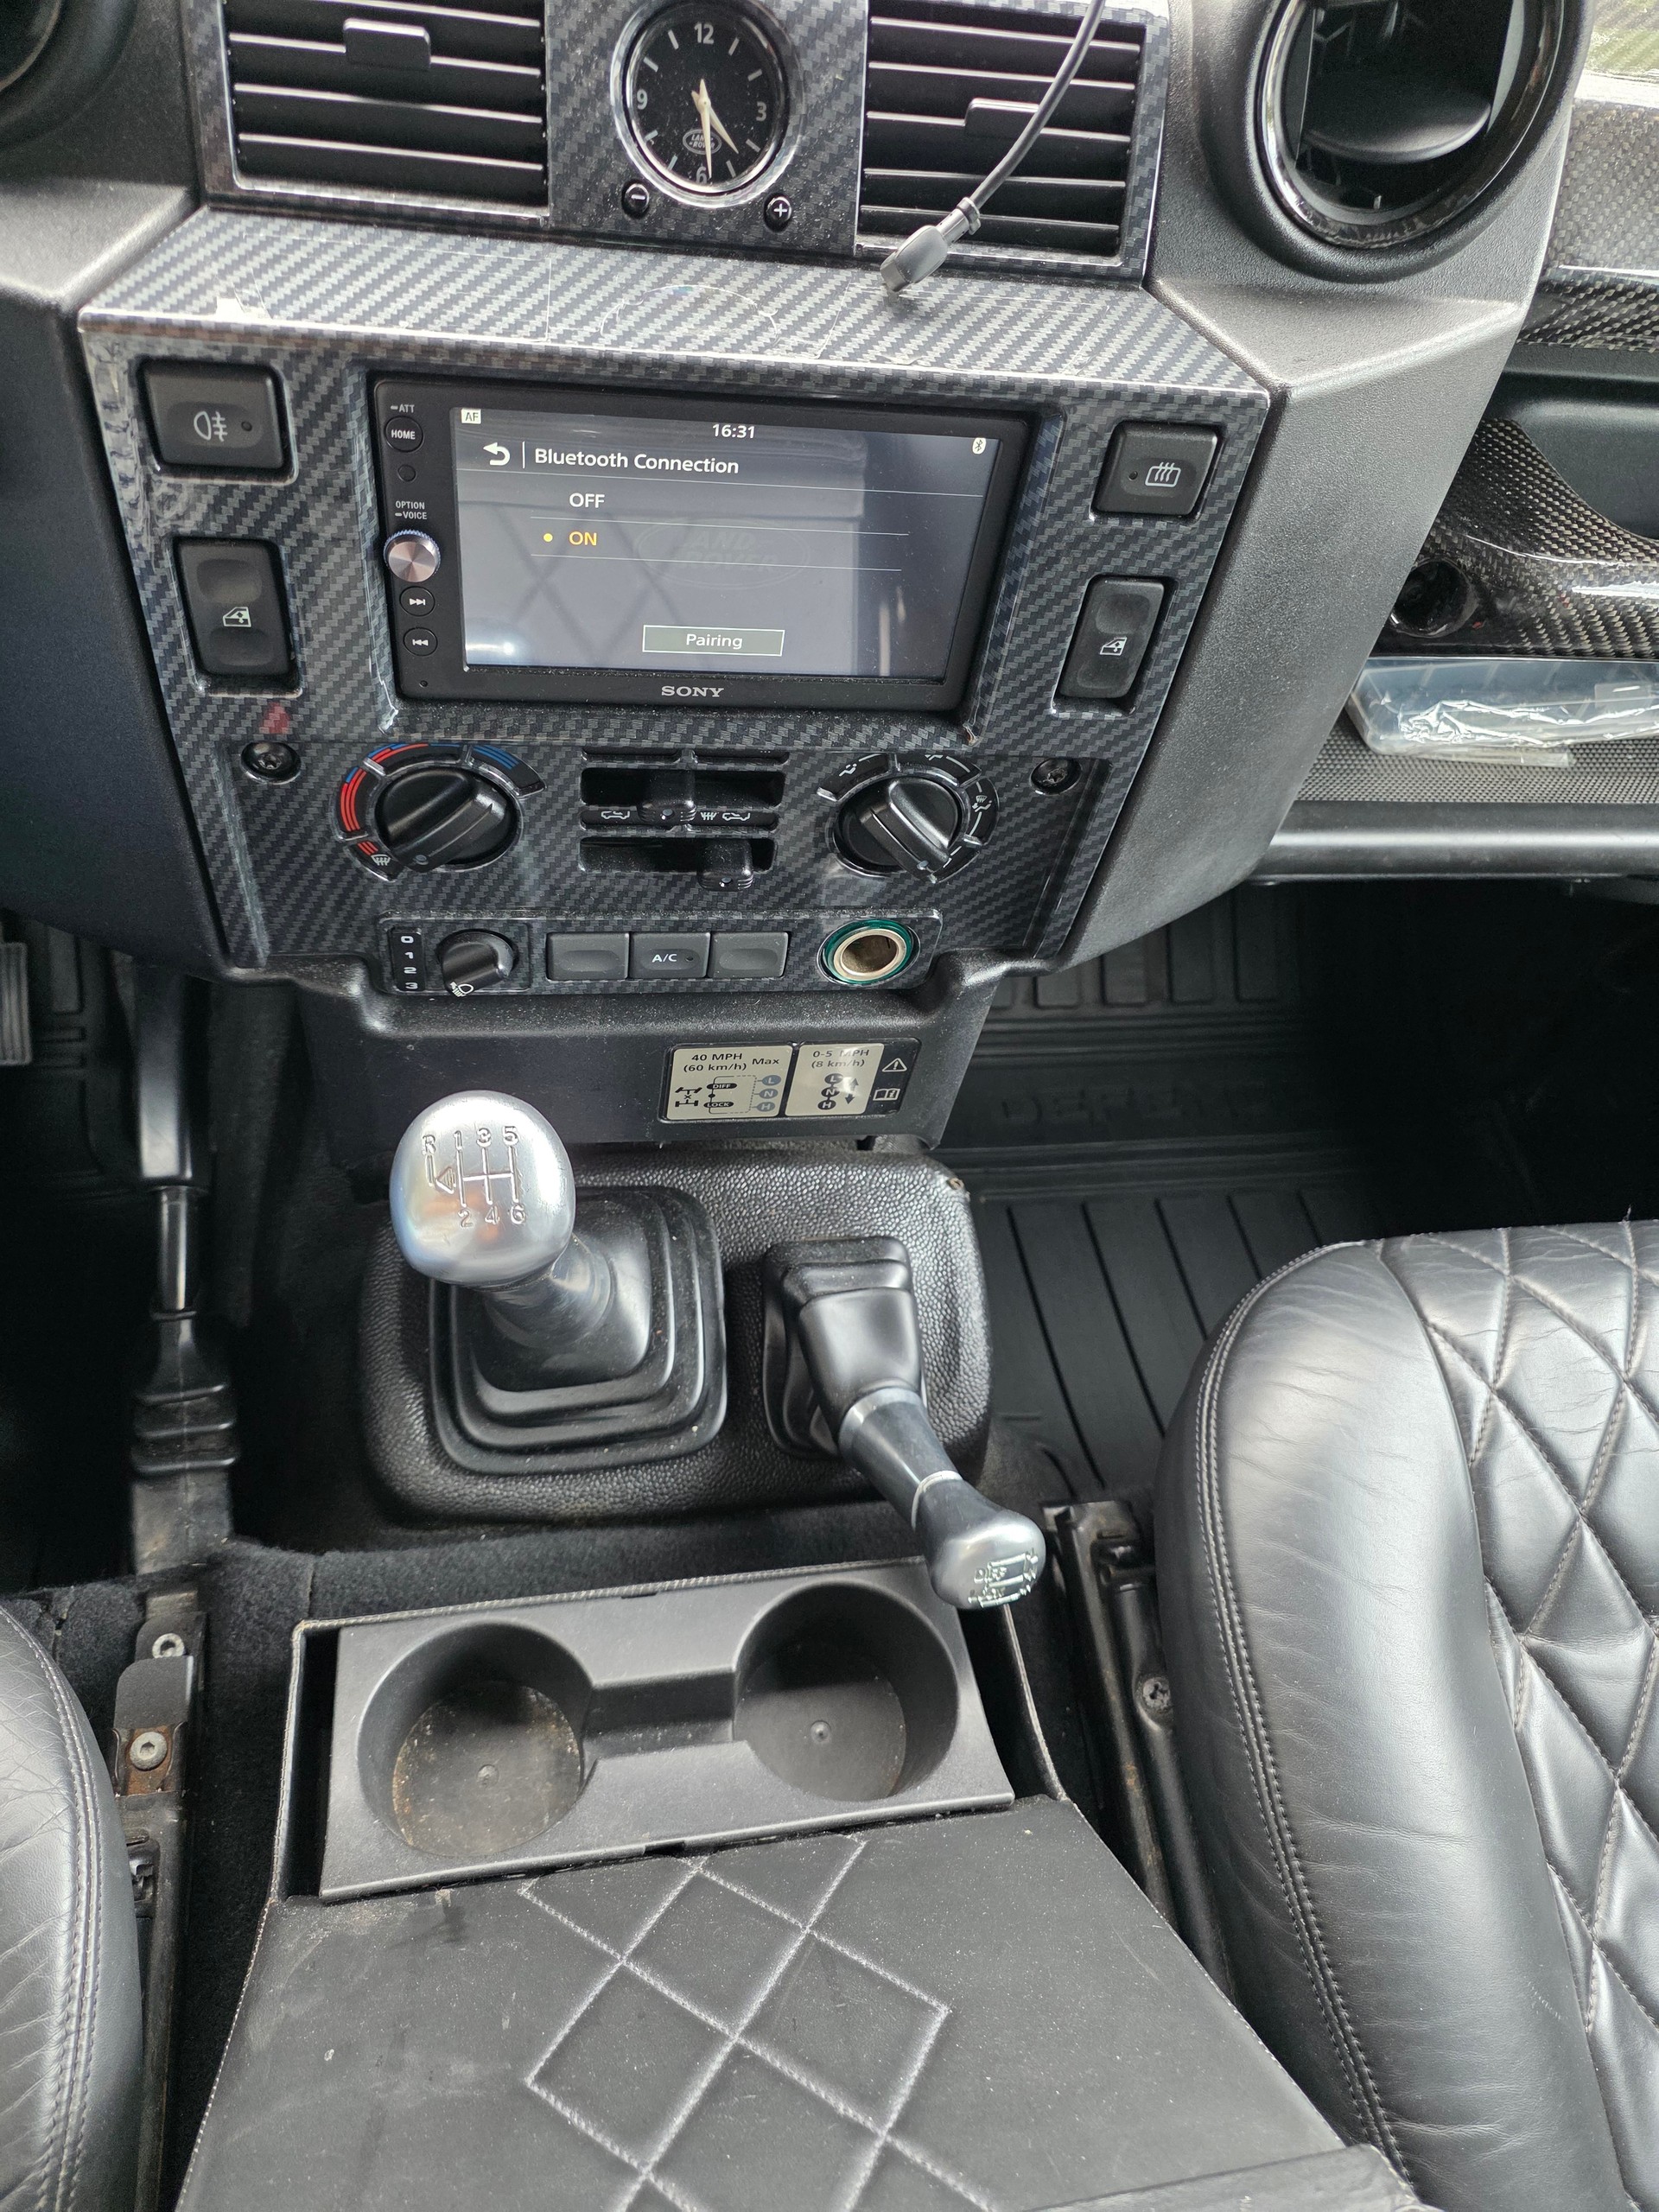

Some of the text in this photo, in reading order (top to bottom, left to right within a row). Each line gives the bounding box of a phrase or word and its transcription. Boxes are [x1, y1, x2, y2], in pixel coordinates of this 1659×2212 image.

[694, 22, 715, 44] 12
[636, 89, 648, 110] 9
[755, 101, 767, 122] 3
[696, 166, 708, 184] 6
[398, 404, 415, 413] ATT
[465, 411, 480, 422] AF
[391, 430, 416, 440] HOME
[711, 423, 756, 439] 16:31
[535, 448, 740, 474] Bluetooth Connection
[396, 500, 425, 510] OPTION
[569, 493, 606, 509] OFF
[403, 511, 428, 520] VOICE
[569, 531, 598, 546] ON
[685, 632, 744, 651] Pairing
[661, 685, 725, 697] SONY
[652, 953, 677, 963] A/C
[712, 1052, 743, 1061] MPH
[839, 1049, 870, 1058] MPH
[683, 1063, 747, 1072] (60 km/h)
[810, 1058, 865, 1069] (8 km/h)
[422, 1125, 519, 1155] R 1 3 5
[457, 1203, 527, 1228] 2 4 6
